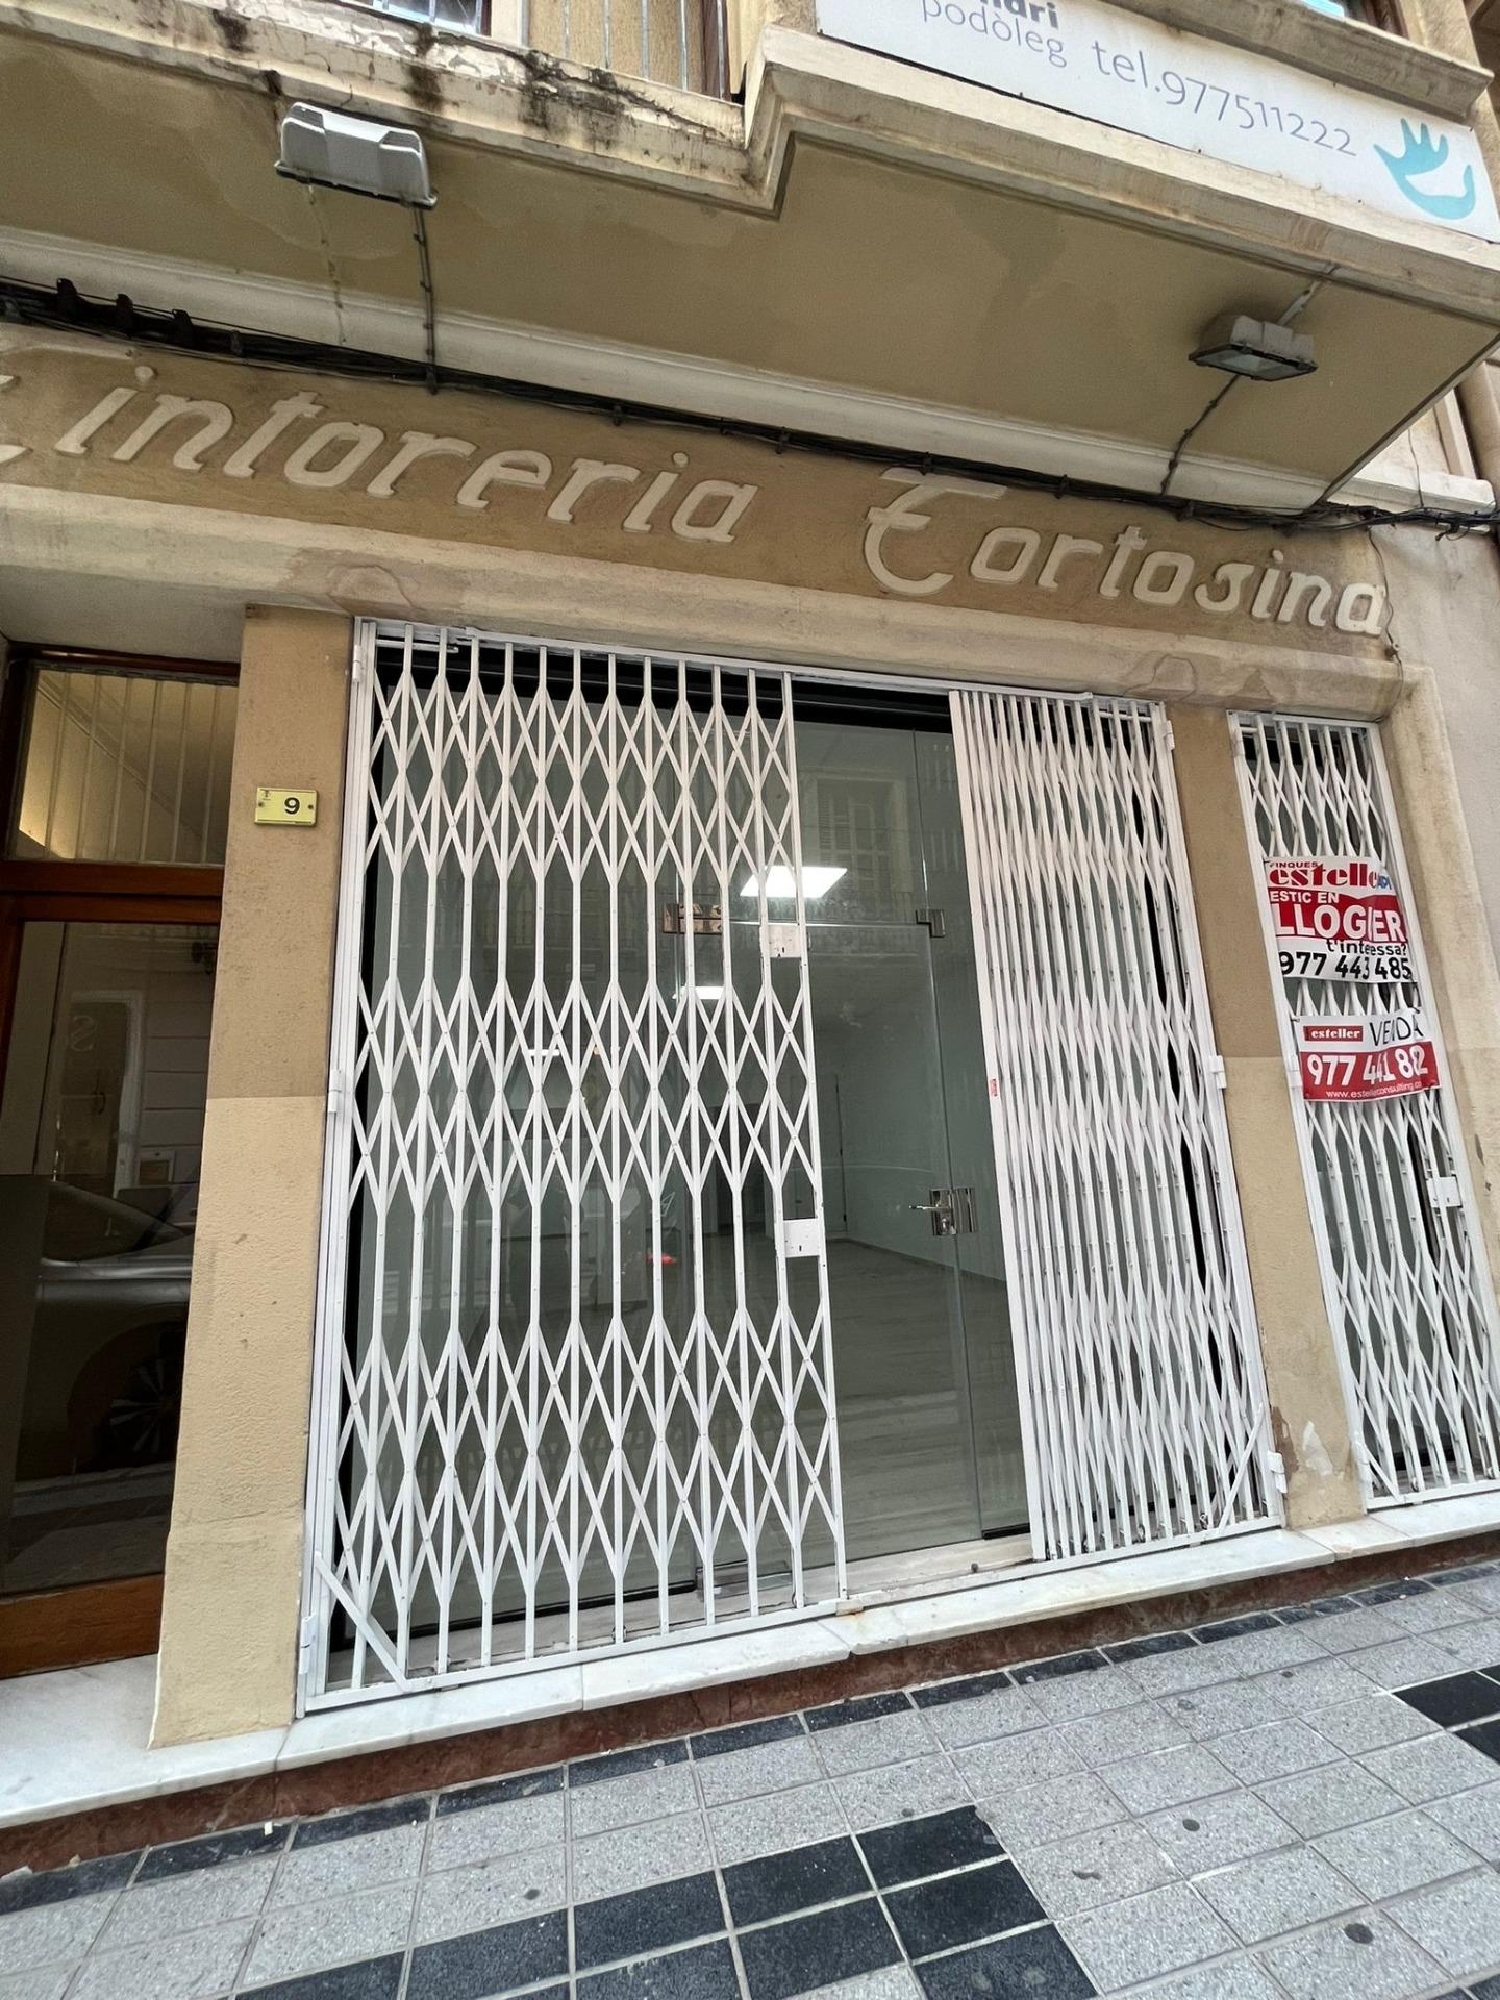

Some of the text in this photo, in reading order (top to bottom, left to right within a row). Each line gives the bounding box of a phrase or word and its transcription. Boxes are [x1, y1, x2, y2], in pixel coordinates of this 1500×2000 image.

[923, 0, 1067, 68] podòleg
[0, 366, 1386, 635] intoreria Tortosina
[284, 797, 300, 815] 9
[1269, 862, 1381, 890] estelle
[1270, 890, 1340, 904] ESTIC EN
[1271, 903, 1407, 942] LLOGER
[1278, 951, 1328, 976] 977
[1374, 956, 1412, 980] 485
[1310, 1028, 1360, 1039] esteller
[1306, 1053, 1357, 1086] 977
